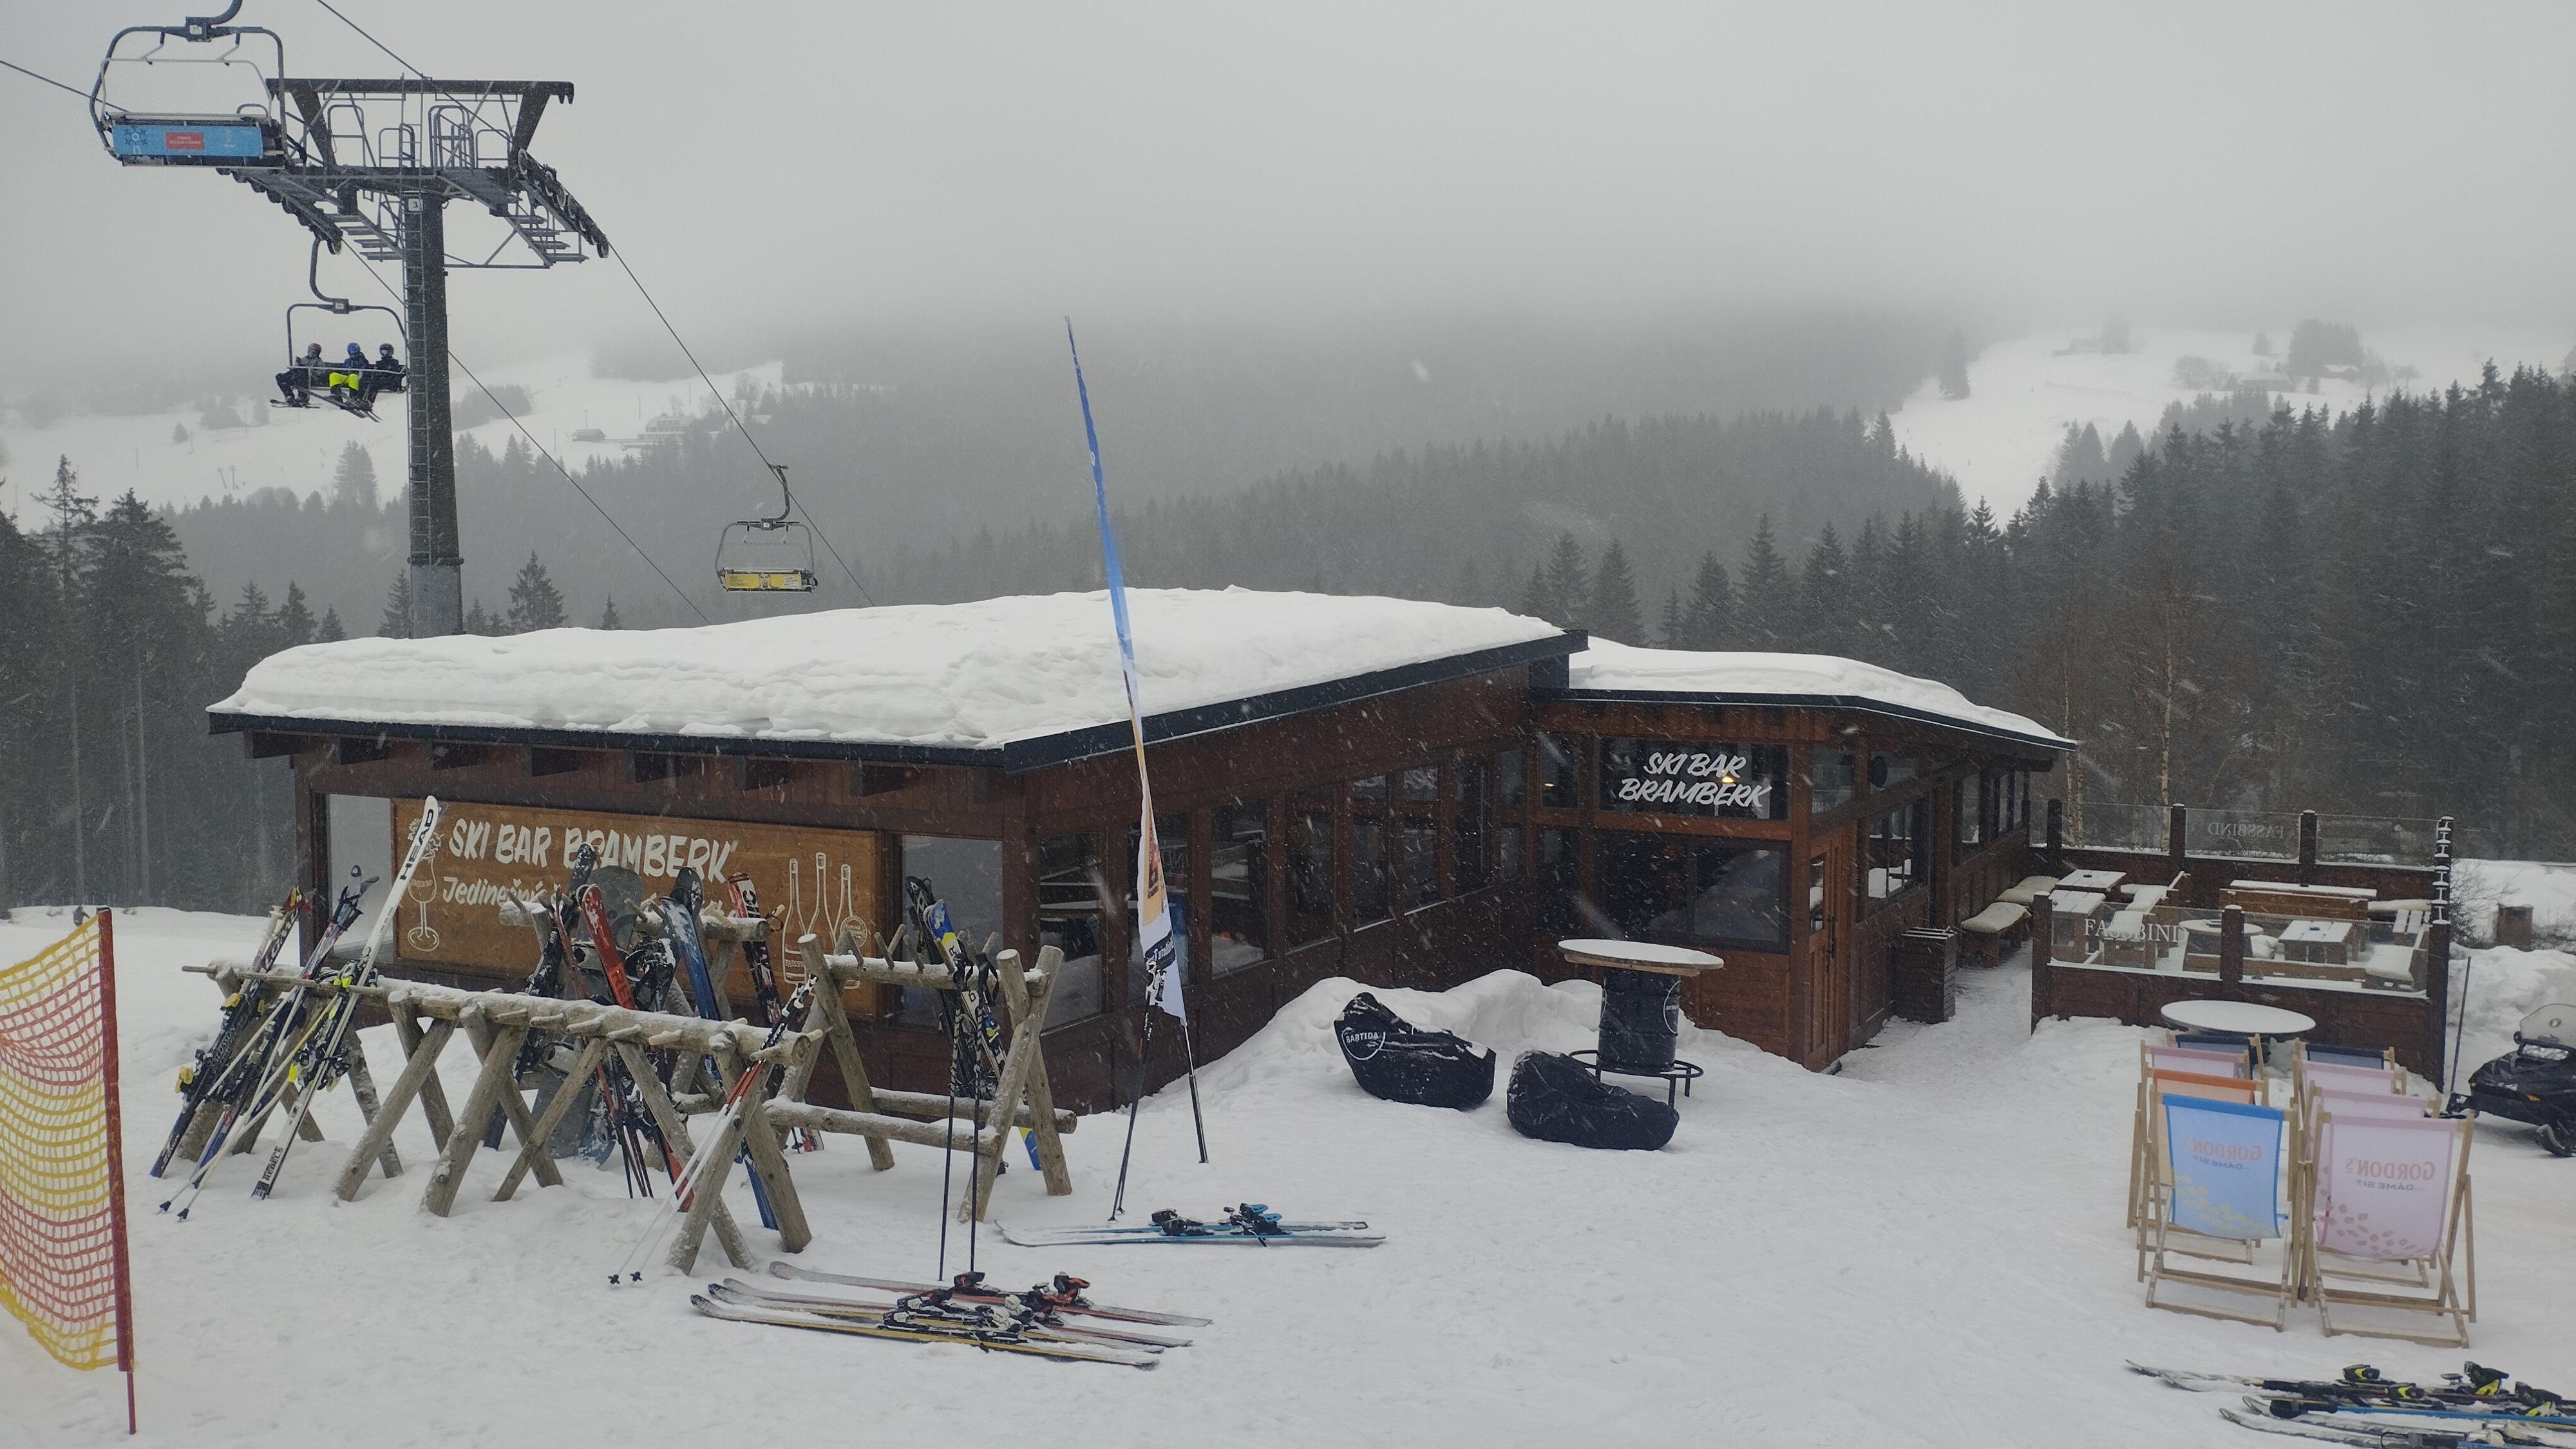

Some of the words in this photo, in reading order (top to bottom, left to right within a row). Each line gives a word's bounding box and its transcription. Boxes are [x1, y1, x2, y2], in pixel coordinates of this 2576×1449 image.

[1643, 752, 1687, 775] SKI
[1687, 753, 1747, 778] BAR
[1619, 778, 1772, 808] BRAMBERK
[399, 808, 434, 880] HEAD
[449, 818, 491, 860] SKI
[495, 823, 552, 868] BAR
[563, 827, 732, 884] BRAMBERK
[1346, 1031, 1379, 1043] BARTIDA
